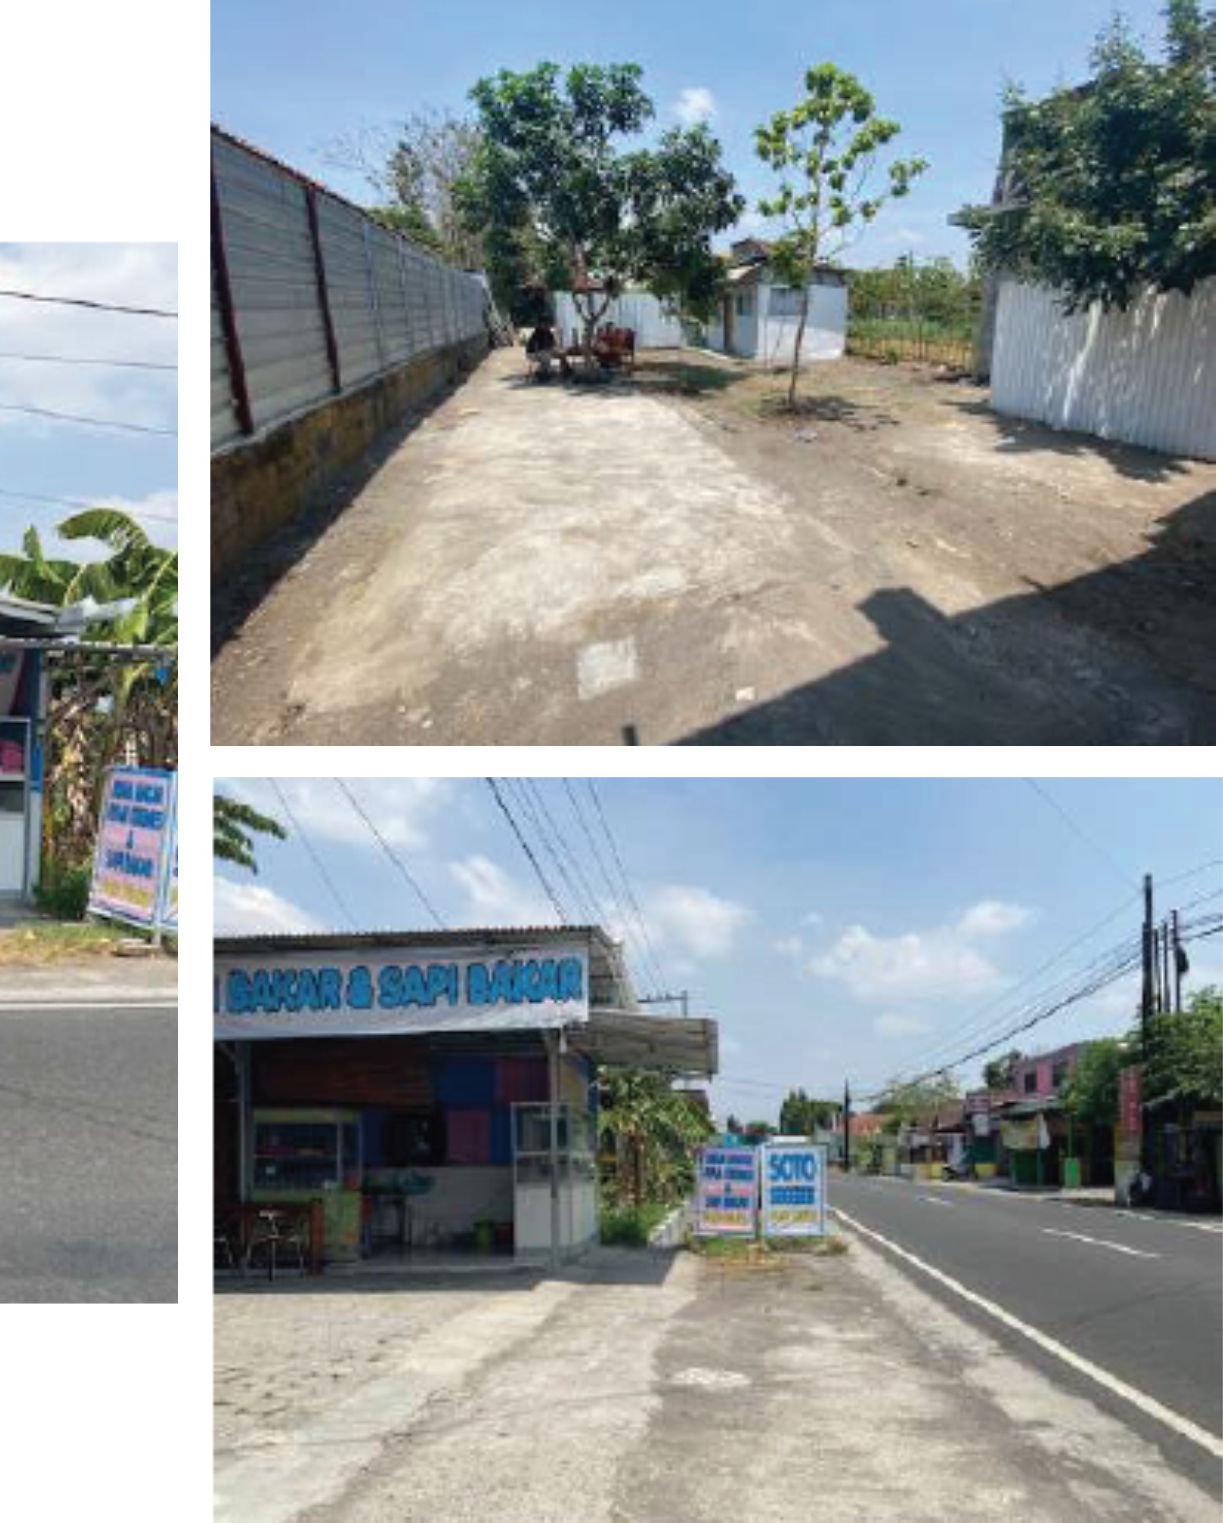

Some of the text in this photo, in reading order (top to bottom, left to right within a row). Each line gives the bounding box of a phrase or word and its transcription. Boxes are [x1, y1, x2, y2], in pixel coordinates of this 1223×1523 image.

[227, 968, 342, 1013] BAKAR
[347, 966, 372, 1009] &
[378, 963, 458, 1008] SAPI
[466, 956, 582, 1005] BAKAR
[768, 1153, 816, 1181] SOTO
